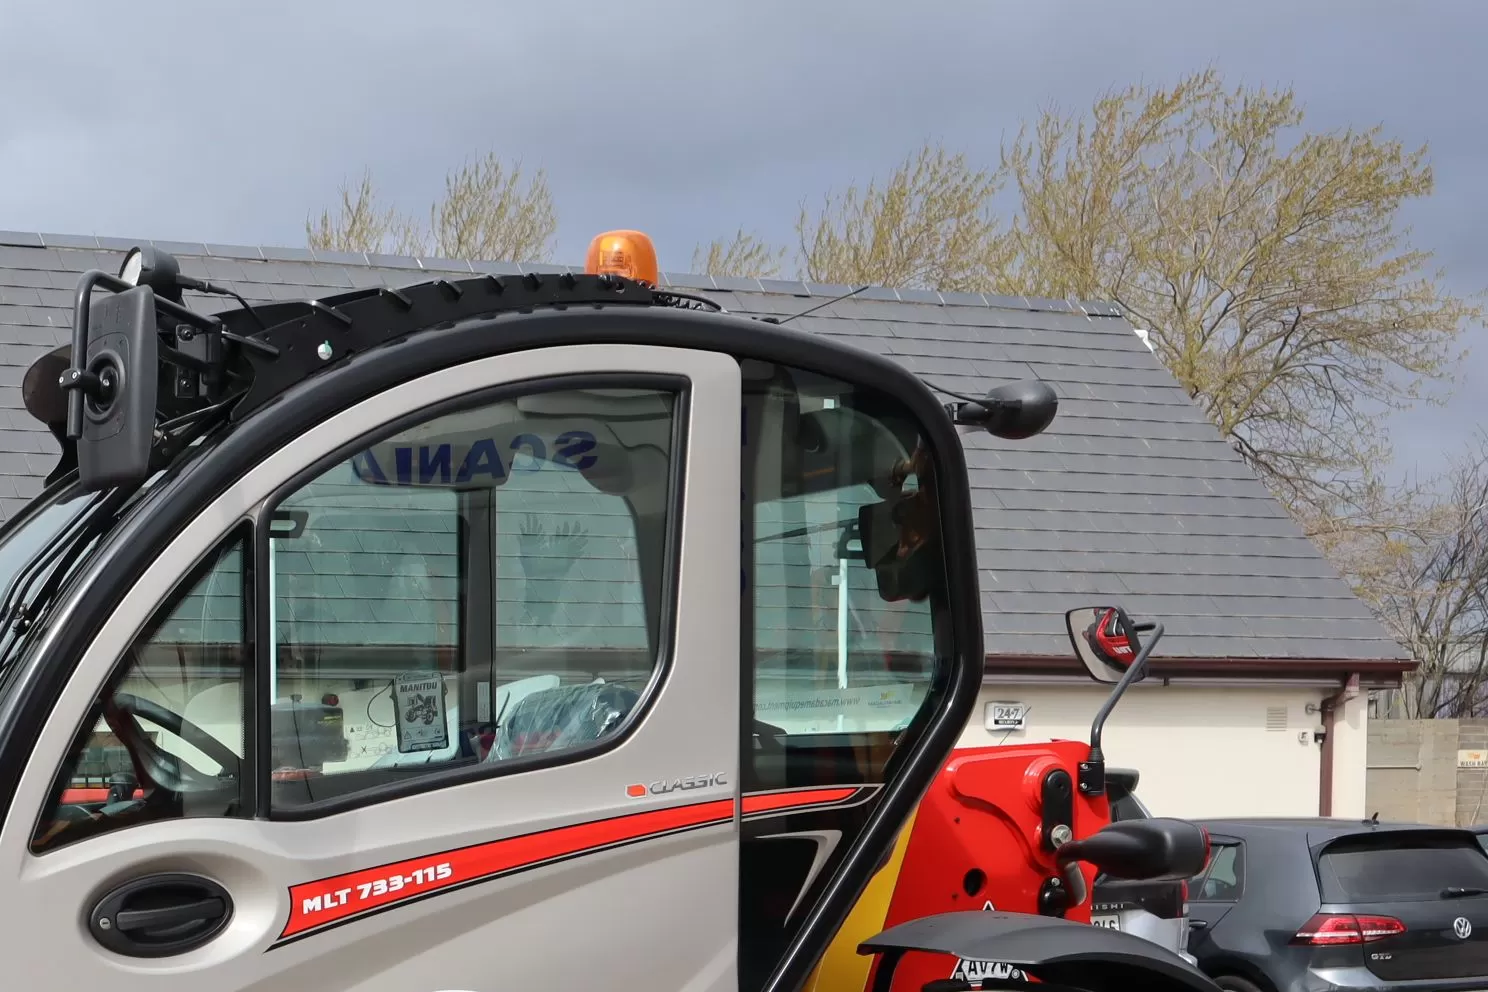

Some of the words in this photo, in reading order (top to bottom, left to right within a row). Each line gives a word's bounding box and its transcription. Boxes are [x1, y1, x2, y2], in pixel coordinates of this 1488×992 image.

[649, 772, 728, 795] CLASSIC
[302, 888, 352, 914] MLT
[356, 862, 453, 900] 733-115
